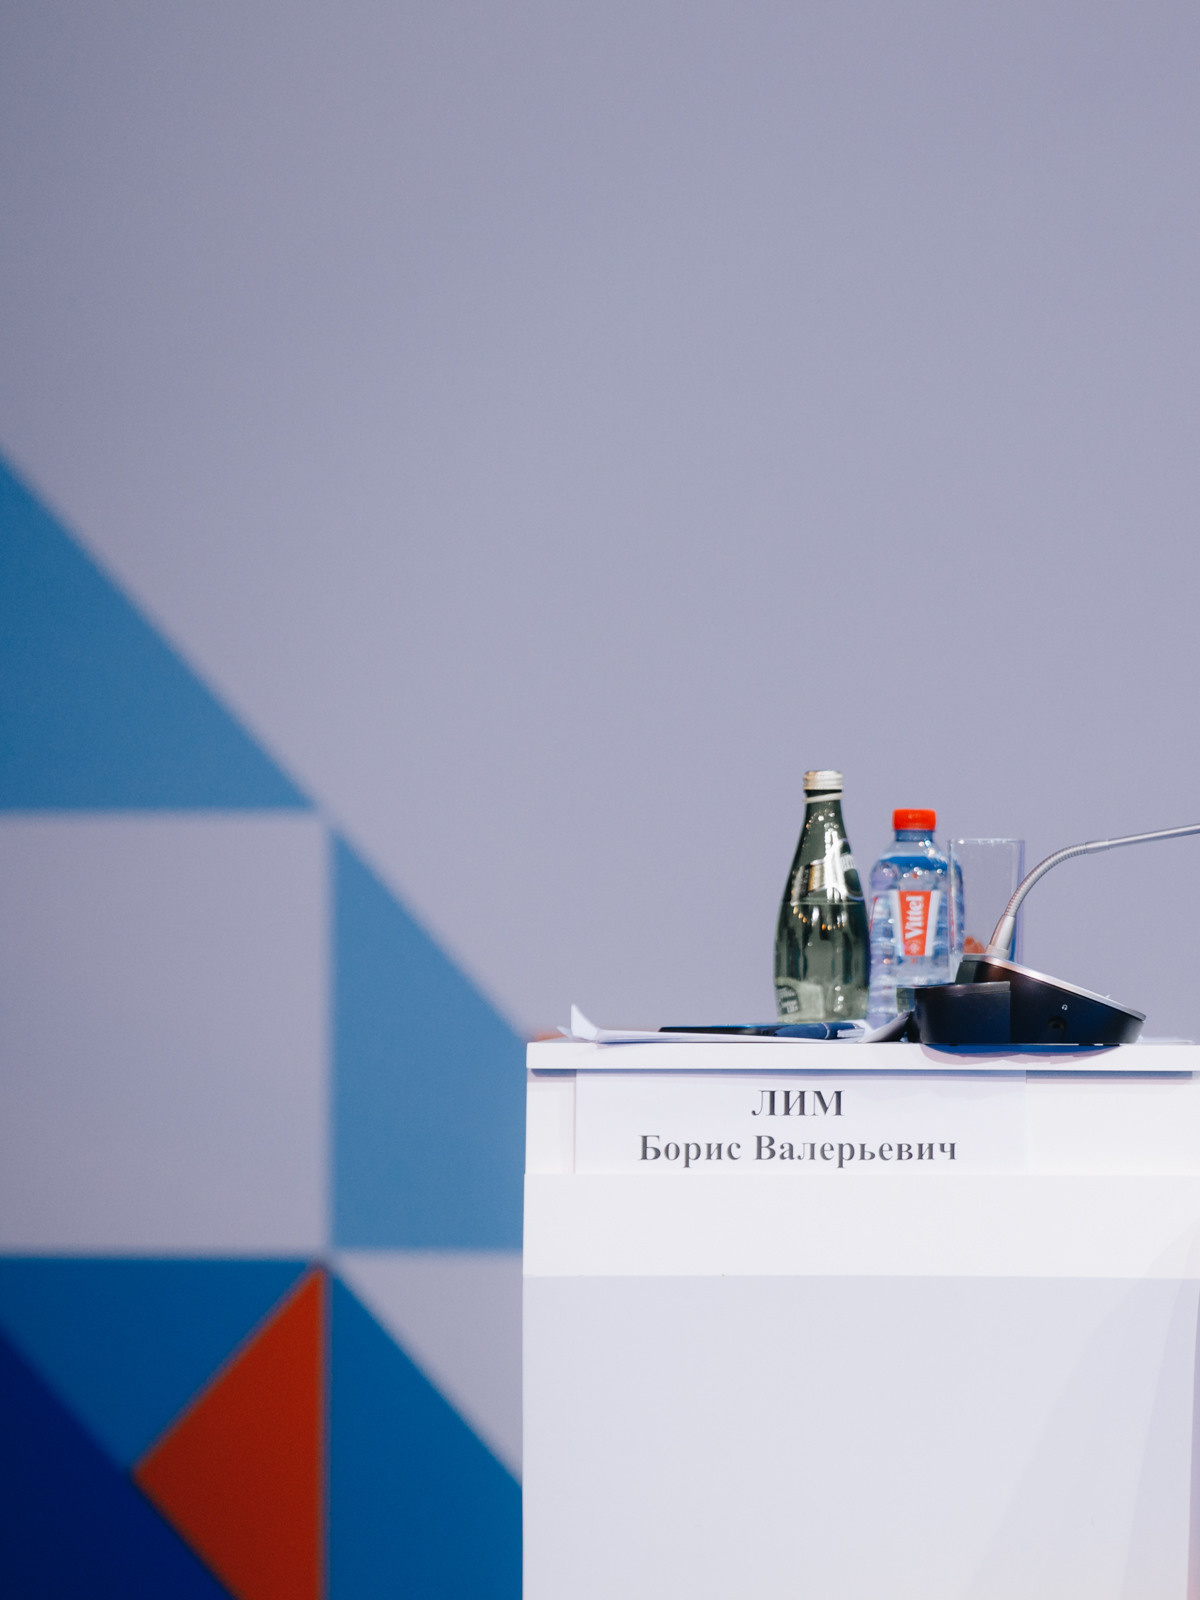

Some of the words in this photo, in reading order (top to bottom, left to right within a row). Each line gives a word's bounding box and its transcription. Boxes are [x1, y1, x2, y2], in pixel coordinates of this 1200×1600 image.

[905, 895, 924, 939] Vittel
[751, 1089, 843, 1117] ЛИМ
[640, 1134, 741, 1169] Борис
[754, 1134, 956, 1169] Валерьевич
